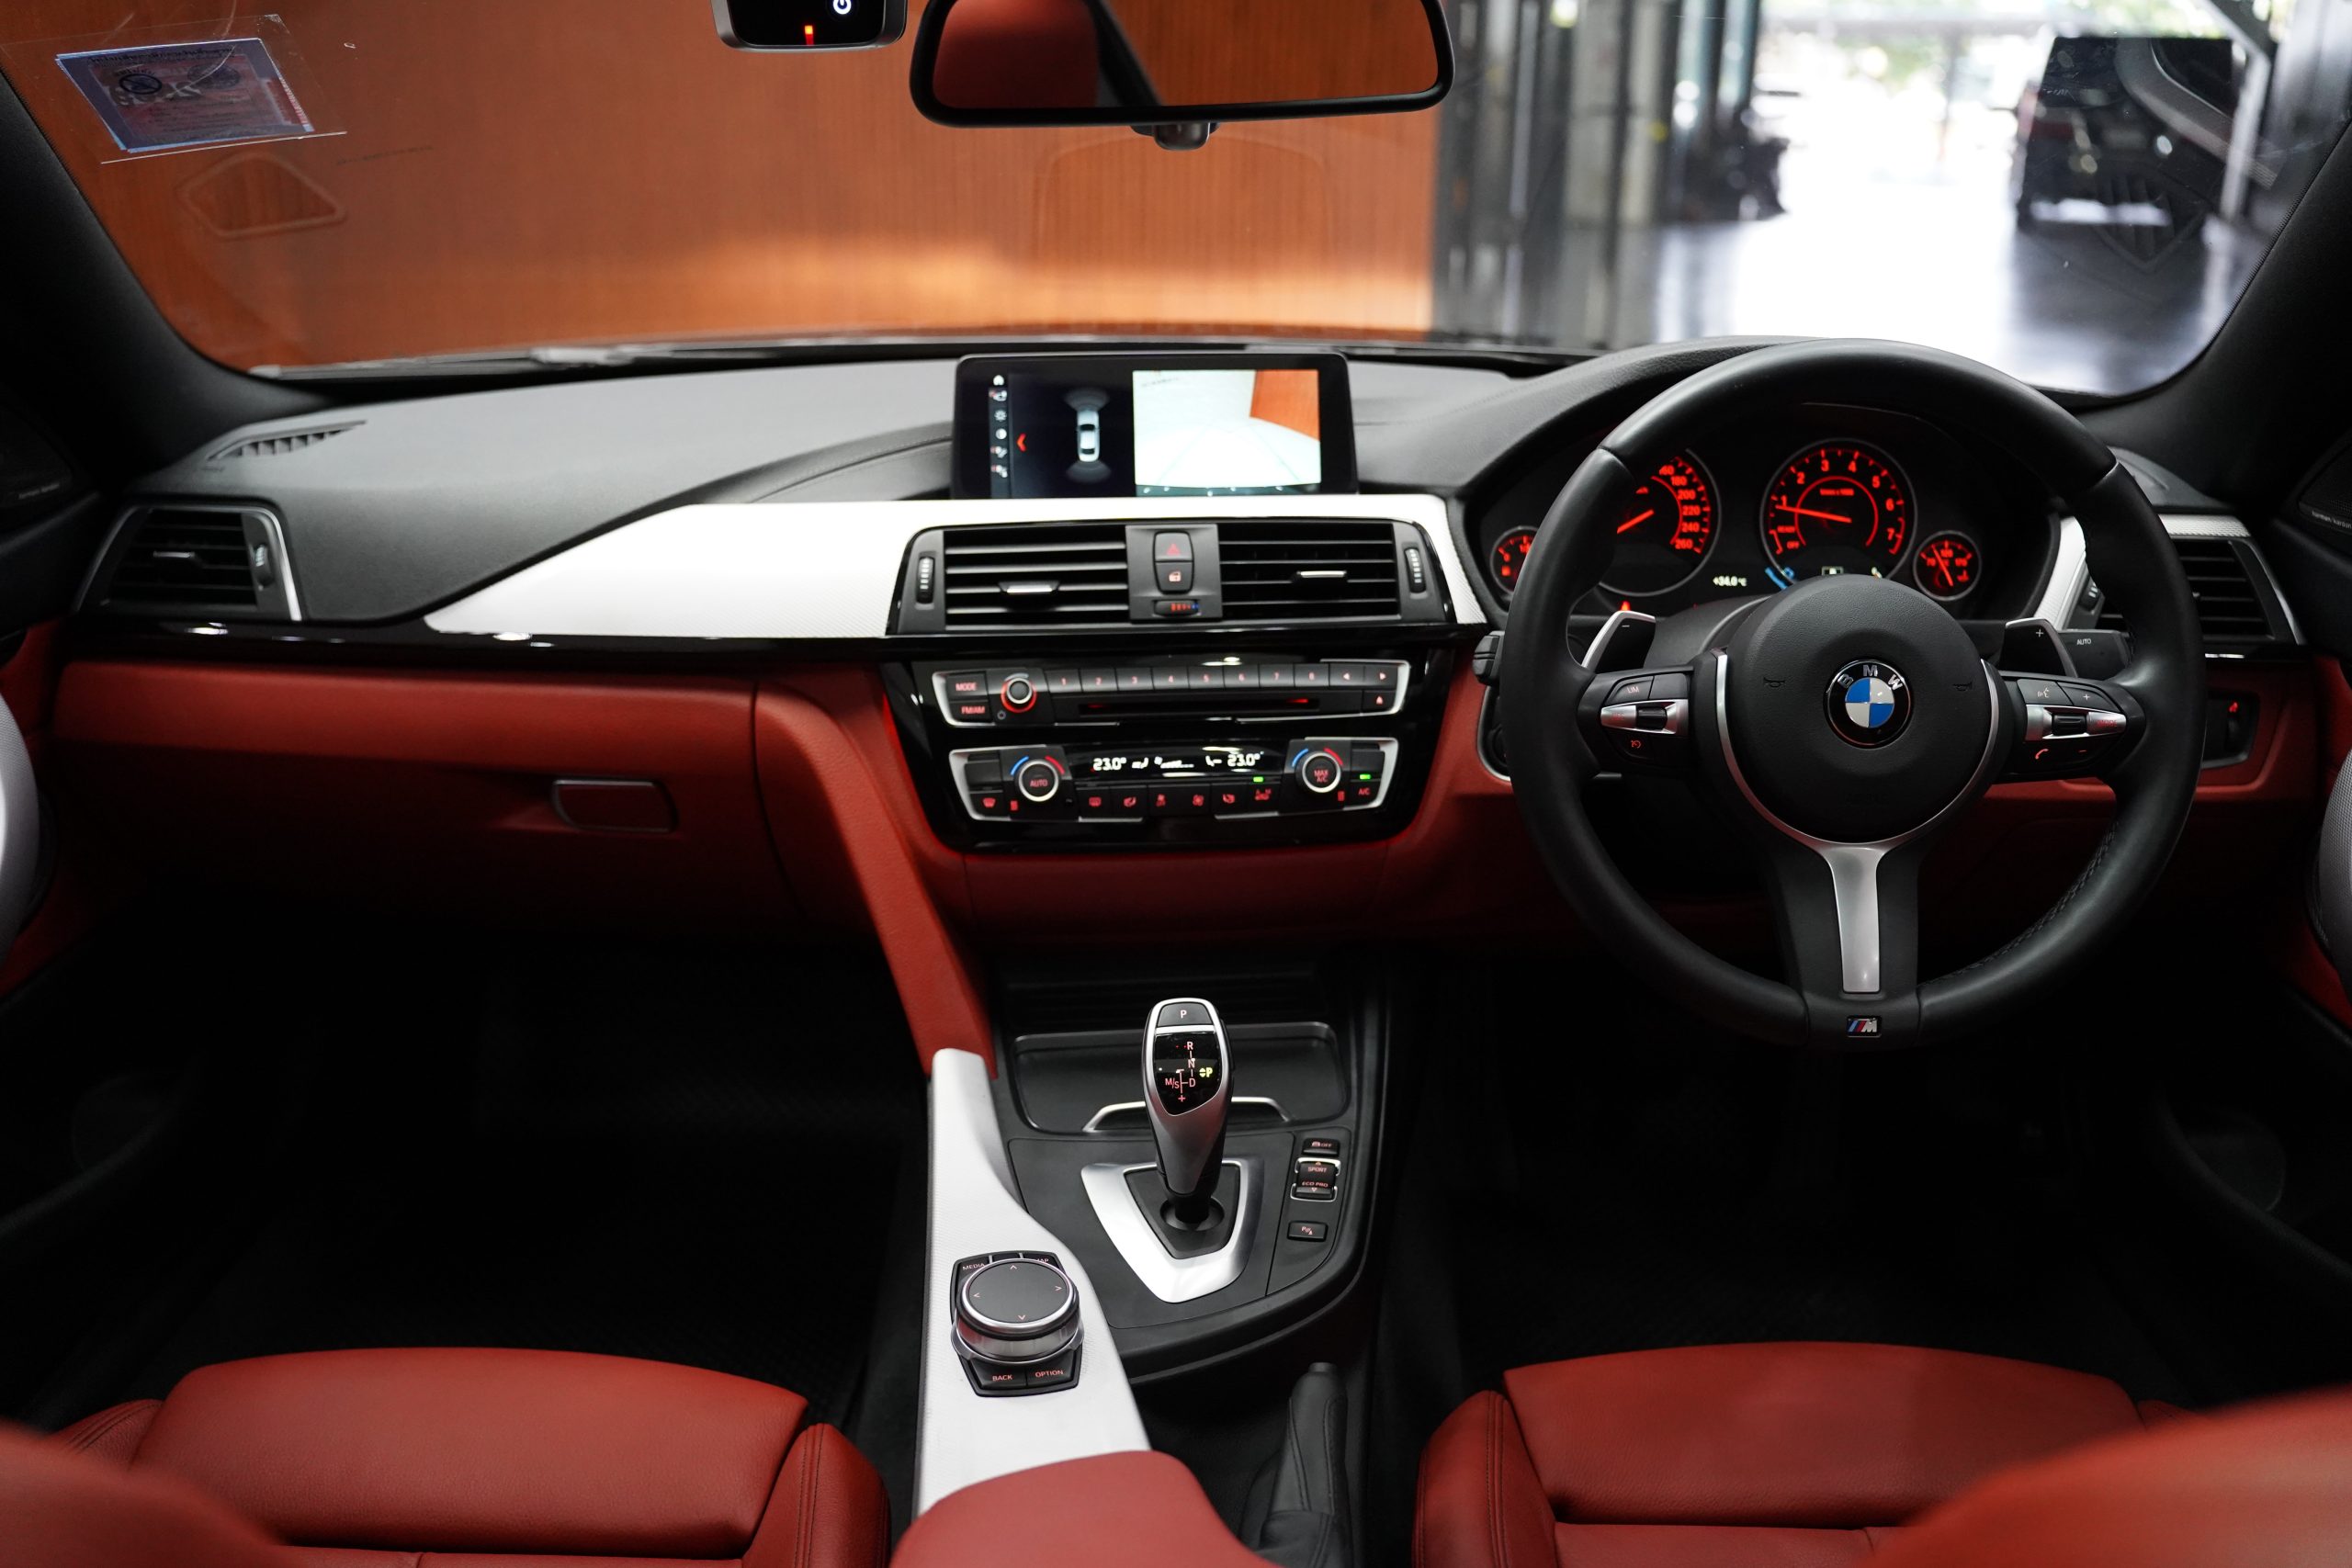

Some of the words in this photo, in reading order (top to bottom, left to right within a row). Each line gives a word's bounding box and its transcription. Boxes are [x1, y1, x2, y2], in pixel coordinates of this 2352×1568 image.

[1821, 459, 1829, 471] 3
[1848, 461, 1857, 472] 4
[1797, 471, 1805, 484] 2
[1872, 476, 1881, 488] 5
[1678, 490, 1696, 500] 200
[1886, 498, 1894, 511] 6
[1682, 505, 1700, 516] 220
[1682, 522, 1700, 533] 240
[1887, 528, 1894, 540] 7
[1675, 538, 1693, 549] 260
[1095, 677, 1102, 685] 2
[1132, 676, 1138, 684] 3
[1168, 675, 1174, 683] 4
[1204, 674, 1210, 682] 5
[1238, 673, 1245, 682] 6
[1273, 672, 1280, 681] 7
[1308, 672, 1315, 681] 8
[1838, 664, 1904, 691] BMW
[956, 682, 977, 691] MODE
[1030, 779, 1048, 787] AUTO
[1180, 1010, 1187, 1019] P
[1186, 1041, 1193, 1050] R
[1188, 1059, 1195, 1068] N
[1206, 1067, 1213, 1077] P
[1165, 1078, 1180, 1089] M/S
[1189, 1078, 1196, 1088] D
[1035, 1369, 1063, 1378] OPTION
